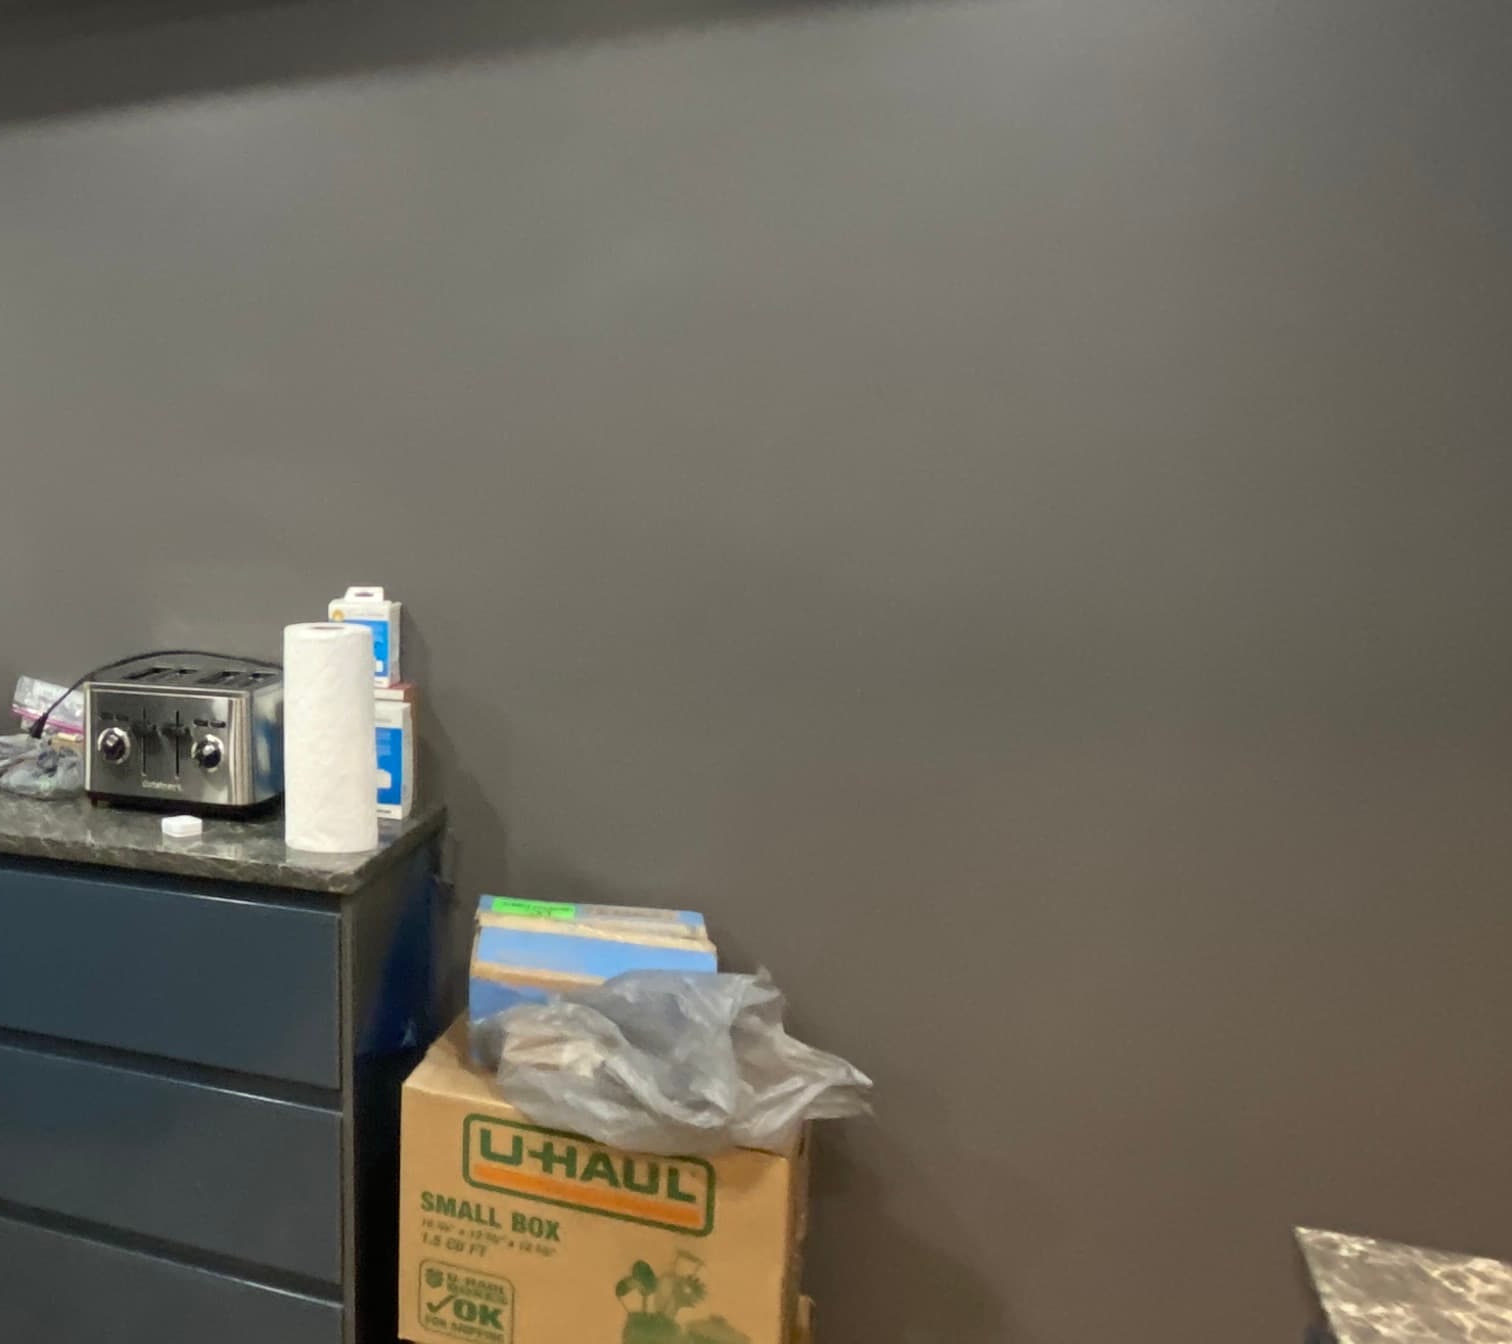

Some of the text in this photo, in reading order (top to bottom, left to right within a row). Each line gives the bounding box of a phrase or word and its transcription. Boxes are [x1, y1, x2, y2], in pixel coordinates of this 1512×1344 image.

[480, 1128, 697, 1203] U-HAUL
[421, 1191, 502, 1229] SMALL
[511, 1211, 560, 1242] BOX
[453, 1298, 504, 1331] OK
